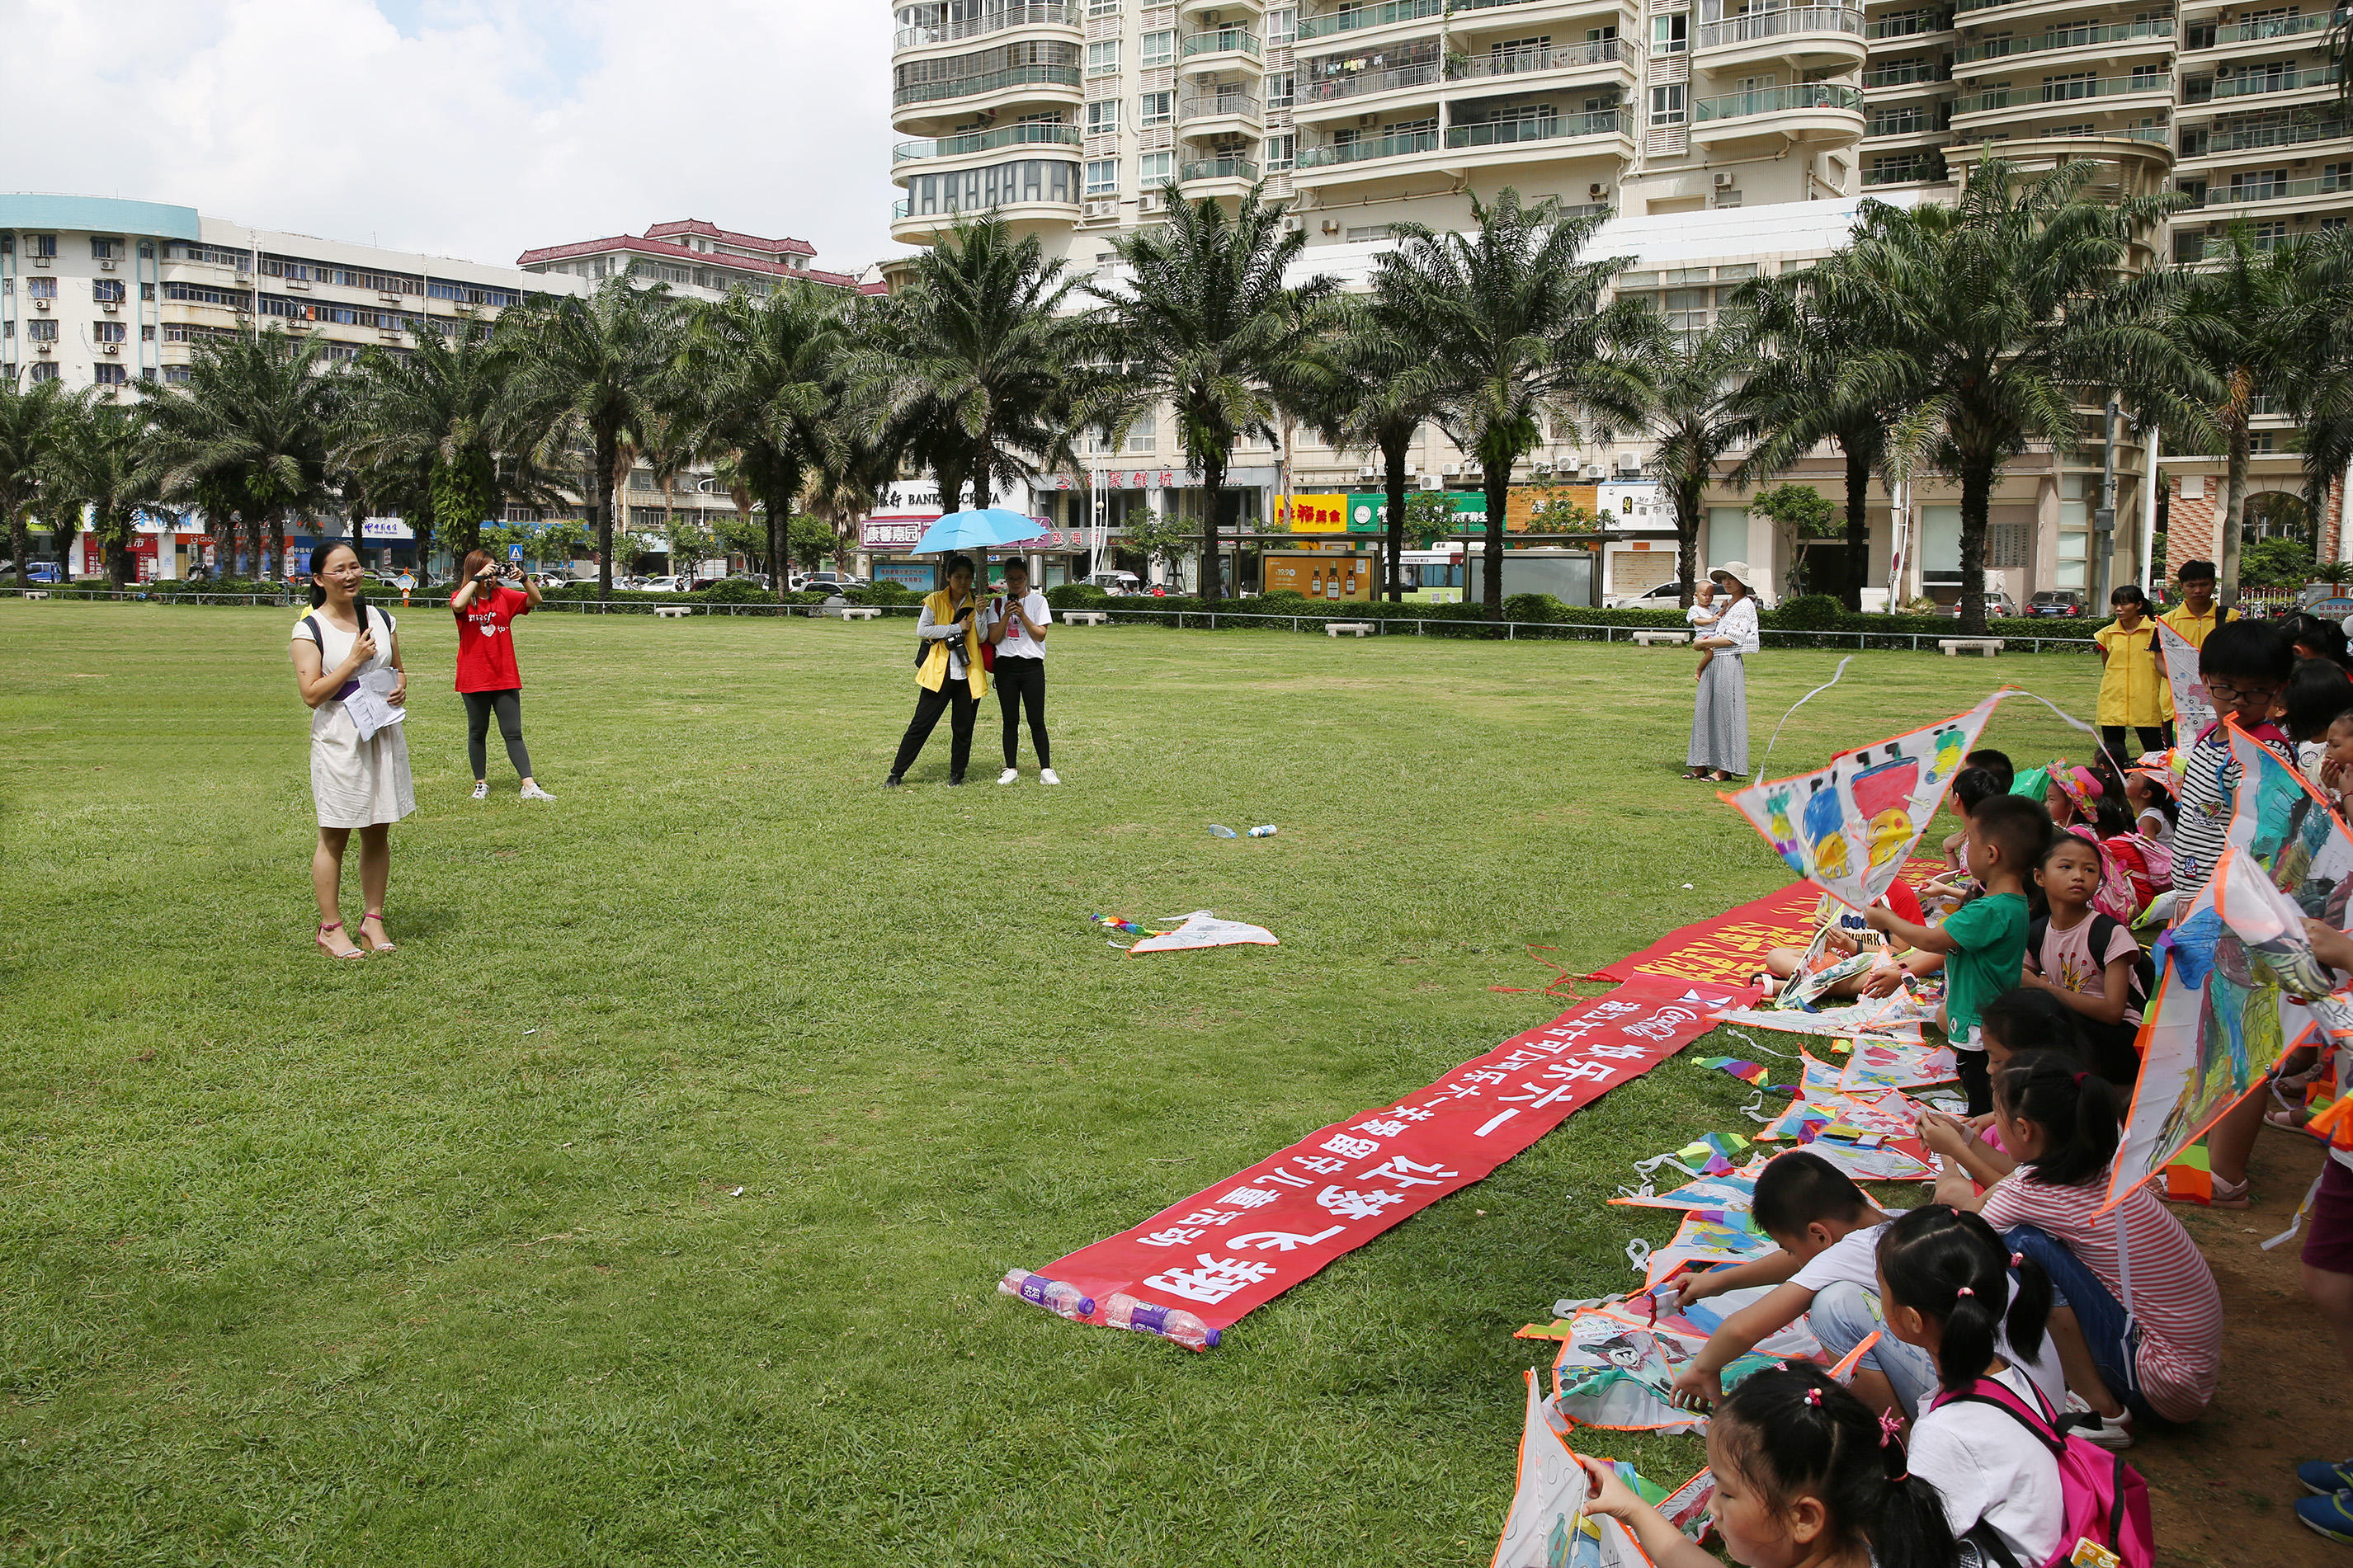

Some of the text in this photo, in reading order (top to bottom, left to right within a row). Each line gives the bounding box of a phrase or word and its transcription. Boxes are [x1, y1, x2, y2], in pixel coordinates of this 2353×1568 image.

[867, 525, 918, 542] 康馨嘉园
[908, 494, 939, 505] BANK
[961, 492, 1001, 503] CHA
[1136, 1001, 1642, 1257] 湛江太古可口可乐六一关爱留守儿童活动
[1473, 1043, 1648, 1137] 快乐六一
[1143, 1147, 1458, 1305] 让梦飞翔
